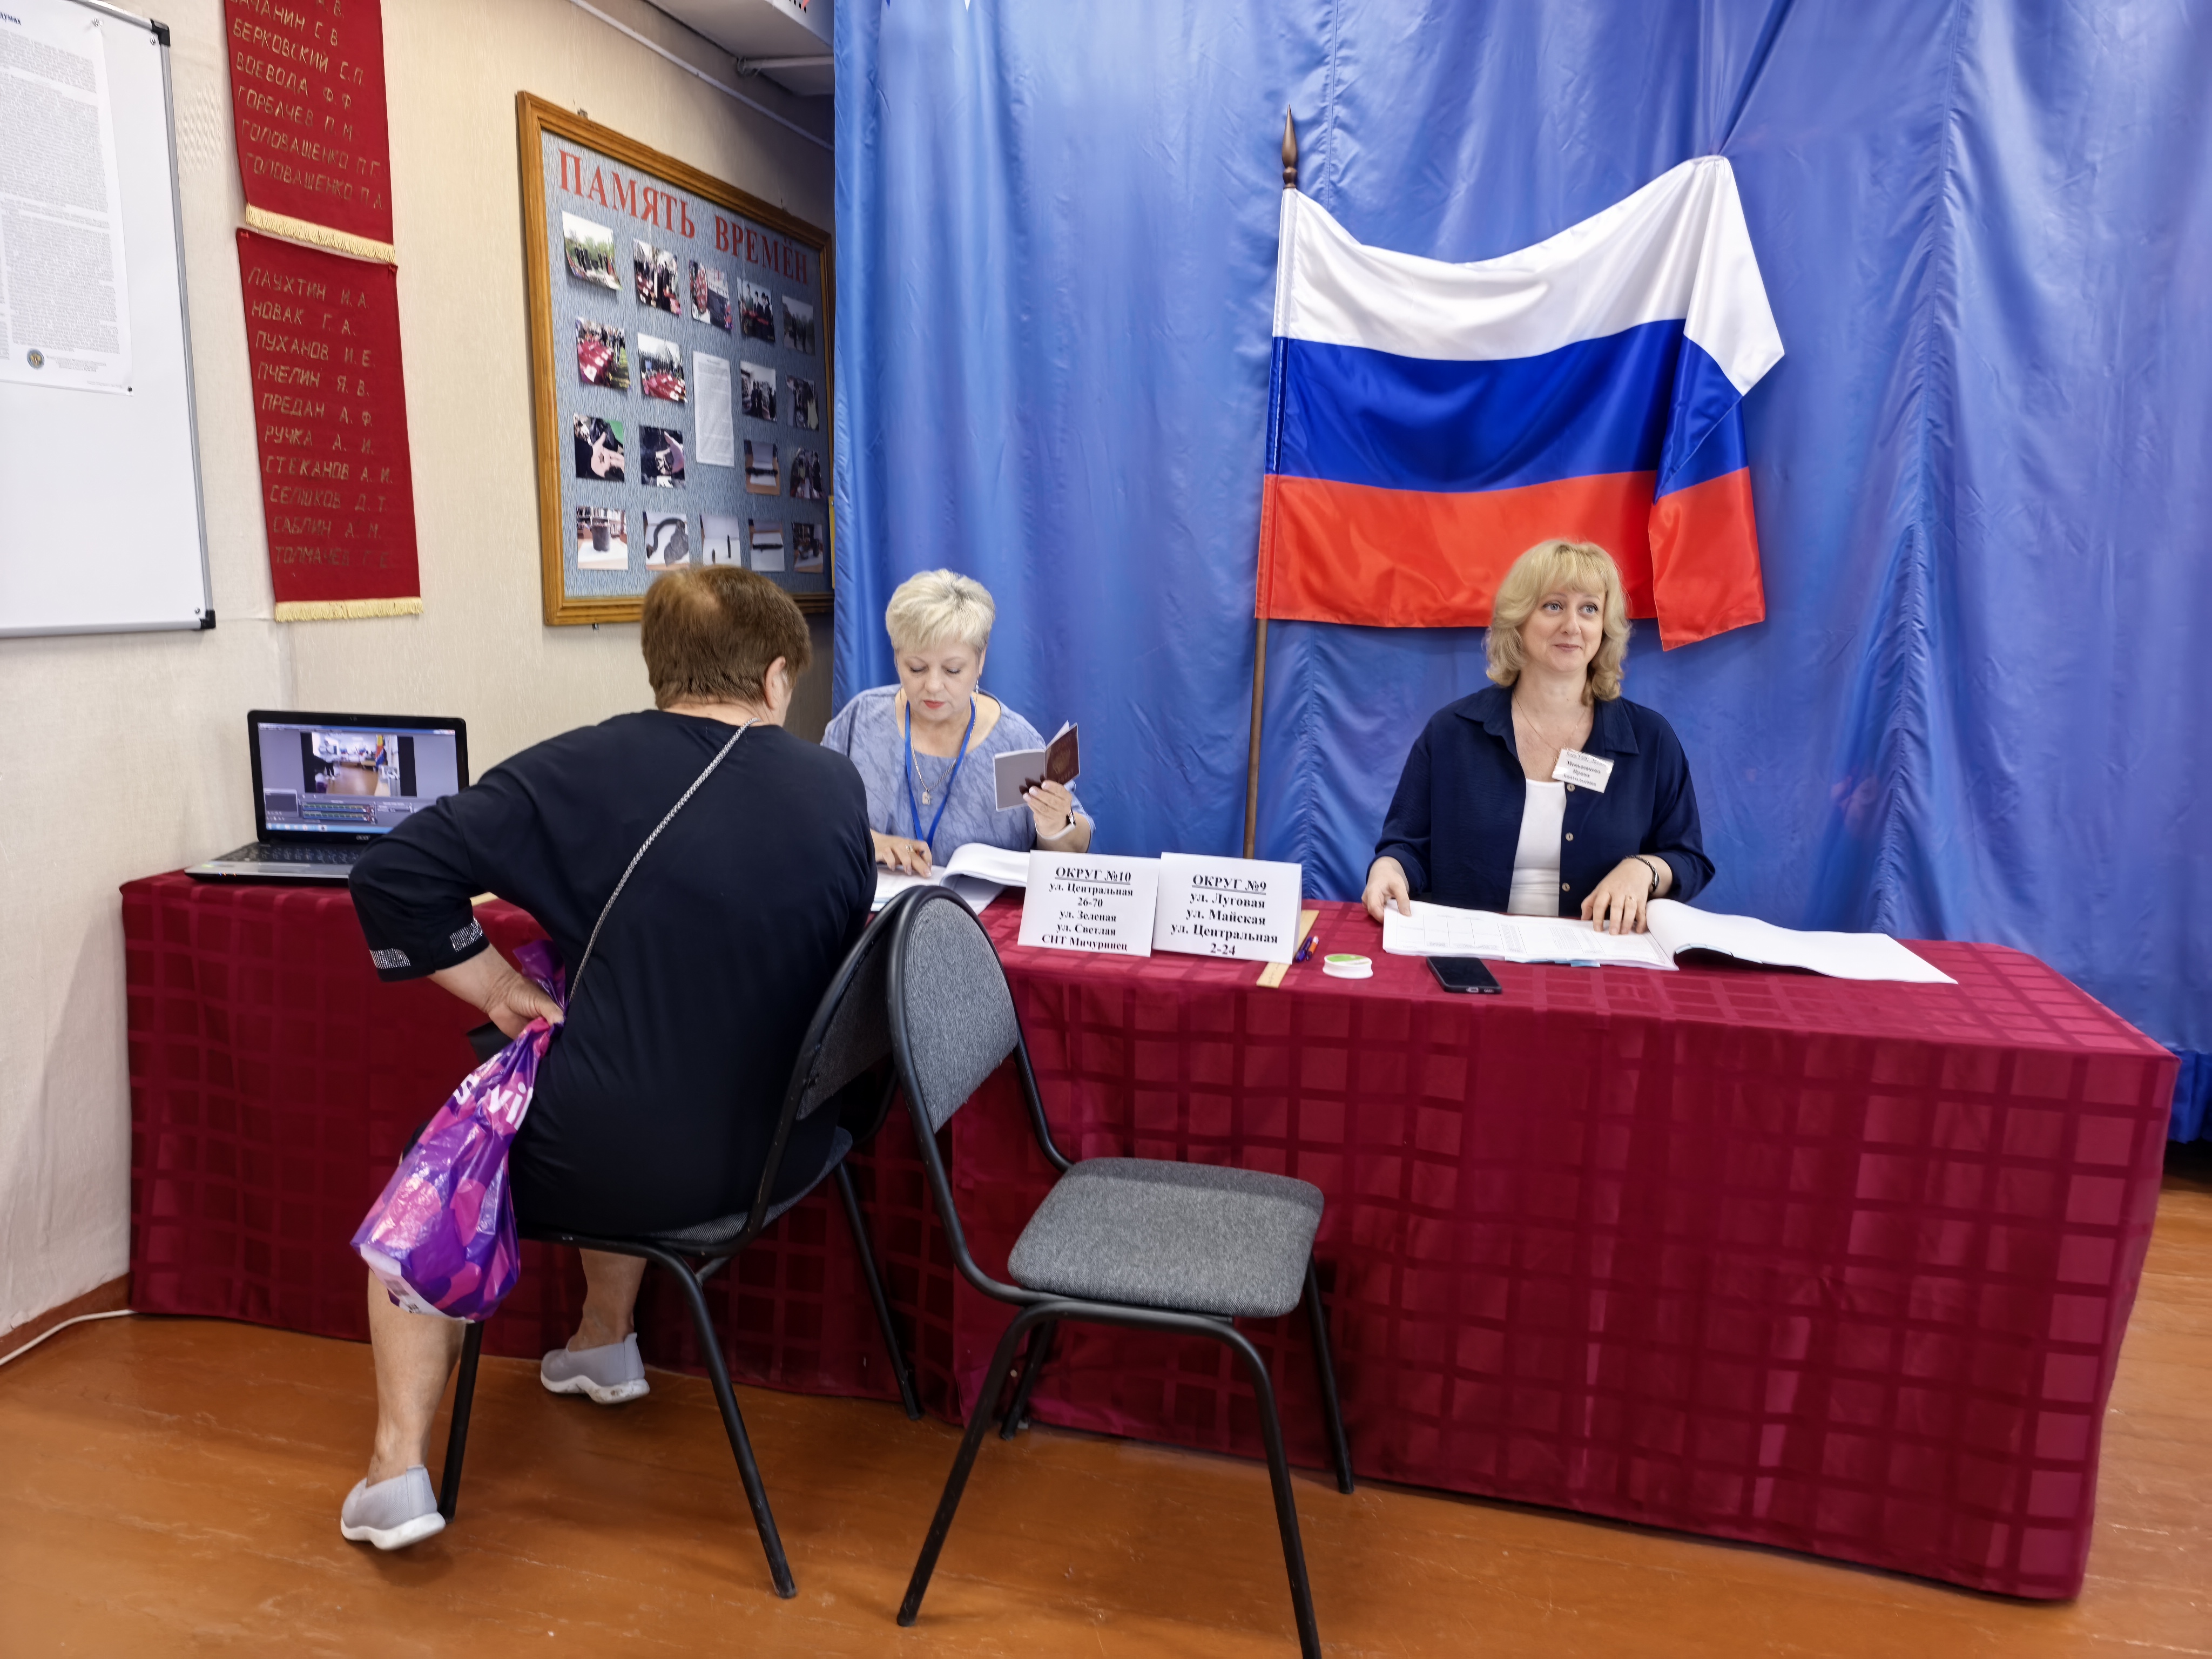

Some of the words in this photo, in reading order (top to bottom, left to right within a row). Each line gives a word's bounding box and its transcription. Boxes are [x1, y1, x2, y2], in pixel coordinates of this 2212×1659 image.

[236, 51, 308, 98] ВОЕВОДА
[238, 85, 313, 127] ГОРБАЧЕВ
[558, 149, 695, 239] ПАМЯТЬ
[714, 215, 808, 285] ВРЕМЁН
[247, 267, 326, 302] ПАУХТИН
[251, 299, 305, 326] НОВАК
[256, 330, 328, 361] ПУХАНОВ
[258, 361, 320, 388] ПЧЕЛИН
[262, 393, 325, 419] ПРЕДАН
[1055, 866, 1102, 880] ОКРУГ
[1104, 869, 1131, 882] №10
[1192, 874, 1242, 889] ОКРУГ
[1245, 879, 1266, 892] №9
[1049, 882, 1063, 892] ул.
[1068, 882, 1133, 896] Центральная
[1077, 896, 1103, 908] 26-70
[1190, 893, 1208, 904] ул.
[1212, 892, 1265, 909] Луговая
[1059, 911, 1074, 920] ул.
[1077, 910, 1116, 922] Зеленая
[1186, 909, 1204, 920] ул.
[1209, 909, 1265, 926] Майская
[1056, 923, 1071, 933] ул.
[1075, 923, 1116, 936] Светлая
[1170, 923, 1189, 935] ул.
[1193, 923, 1278, 944] Центральная
[1042, 934, 1067, 945] СНТ
[1069, 936, 1127, 952] Мичуринец
[1210, 942, 1236, 956] 2-24
